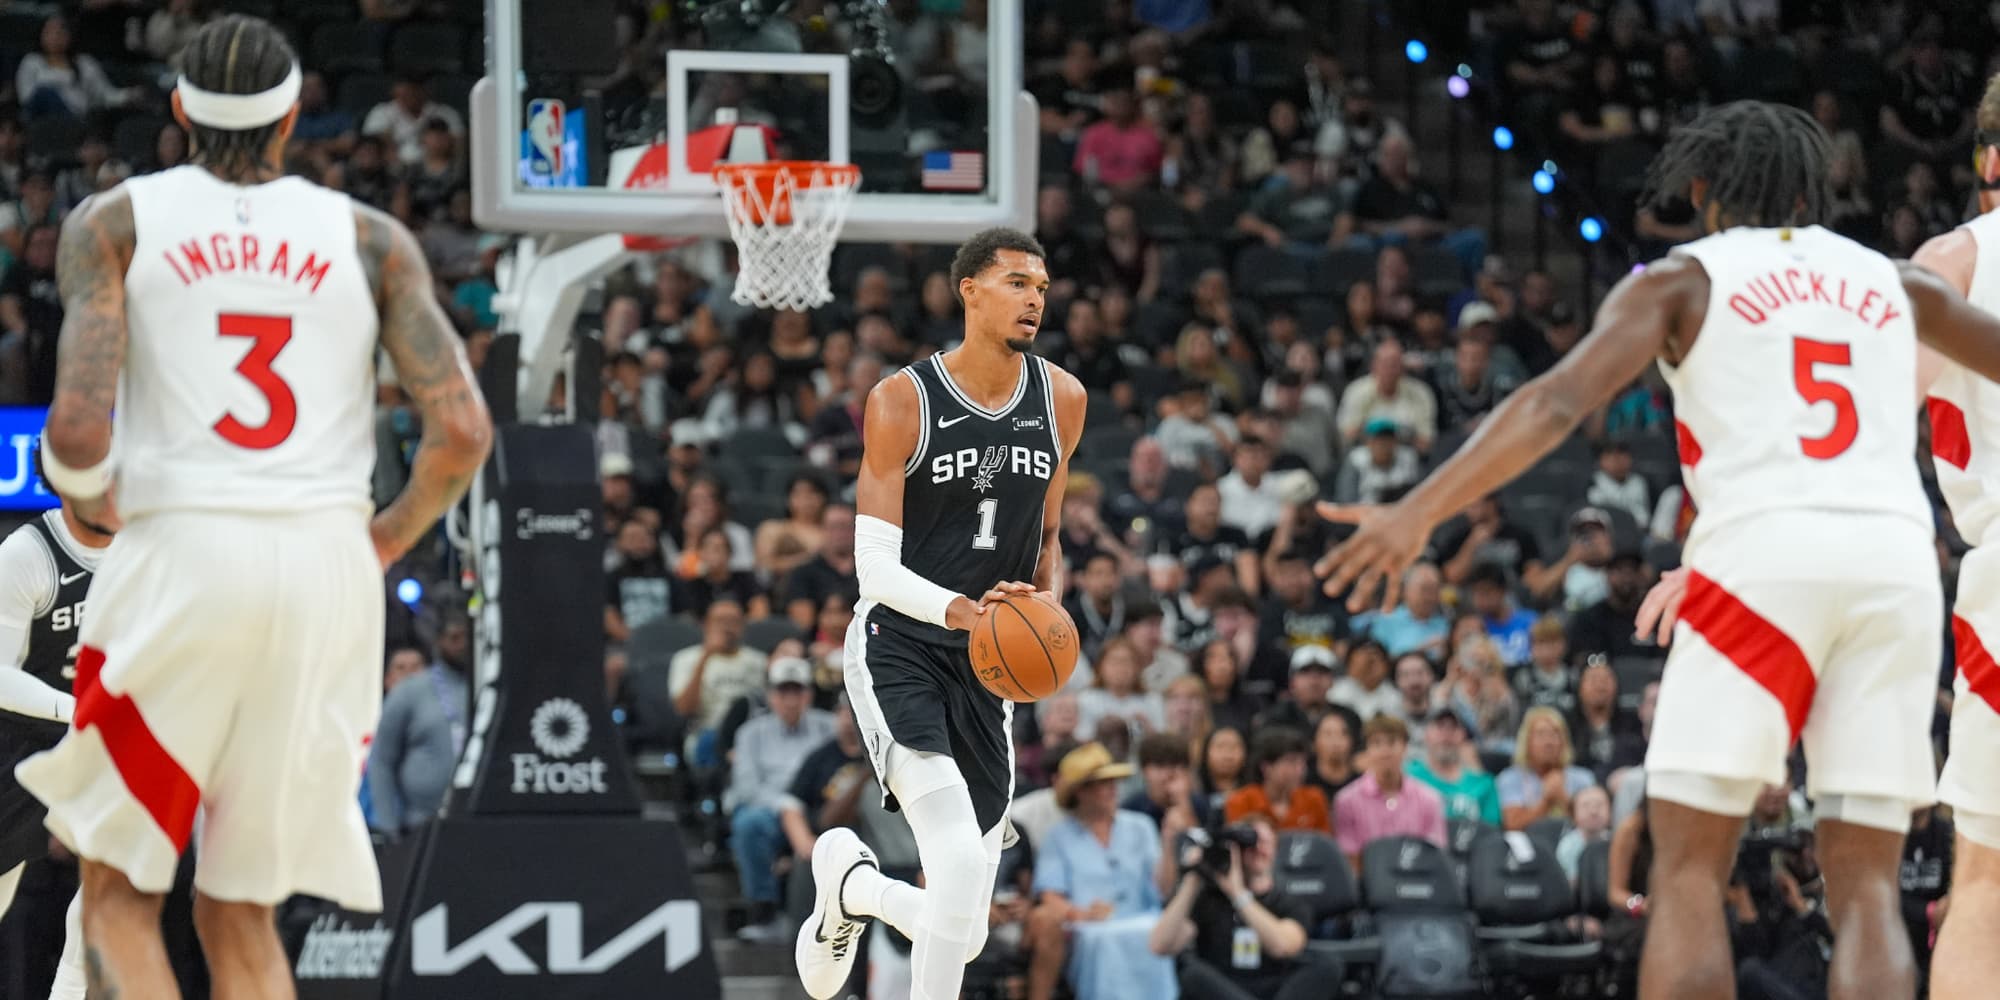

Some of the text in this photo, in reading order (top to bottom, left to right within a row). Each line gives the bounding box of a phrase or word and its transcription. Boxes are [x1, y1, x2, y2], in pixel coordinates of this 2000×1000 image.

[163, 232, 332, 295] INGRAM
[1728, 268, 1900, 331] QUICKLEY
[212, 312, 297, 450] 3
[1792, 335, 1860, 460] 5
[972, 497, 998, 550] 1
[510, 753, 608, 794] Frost
